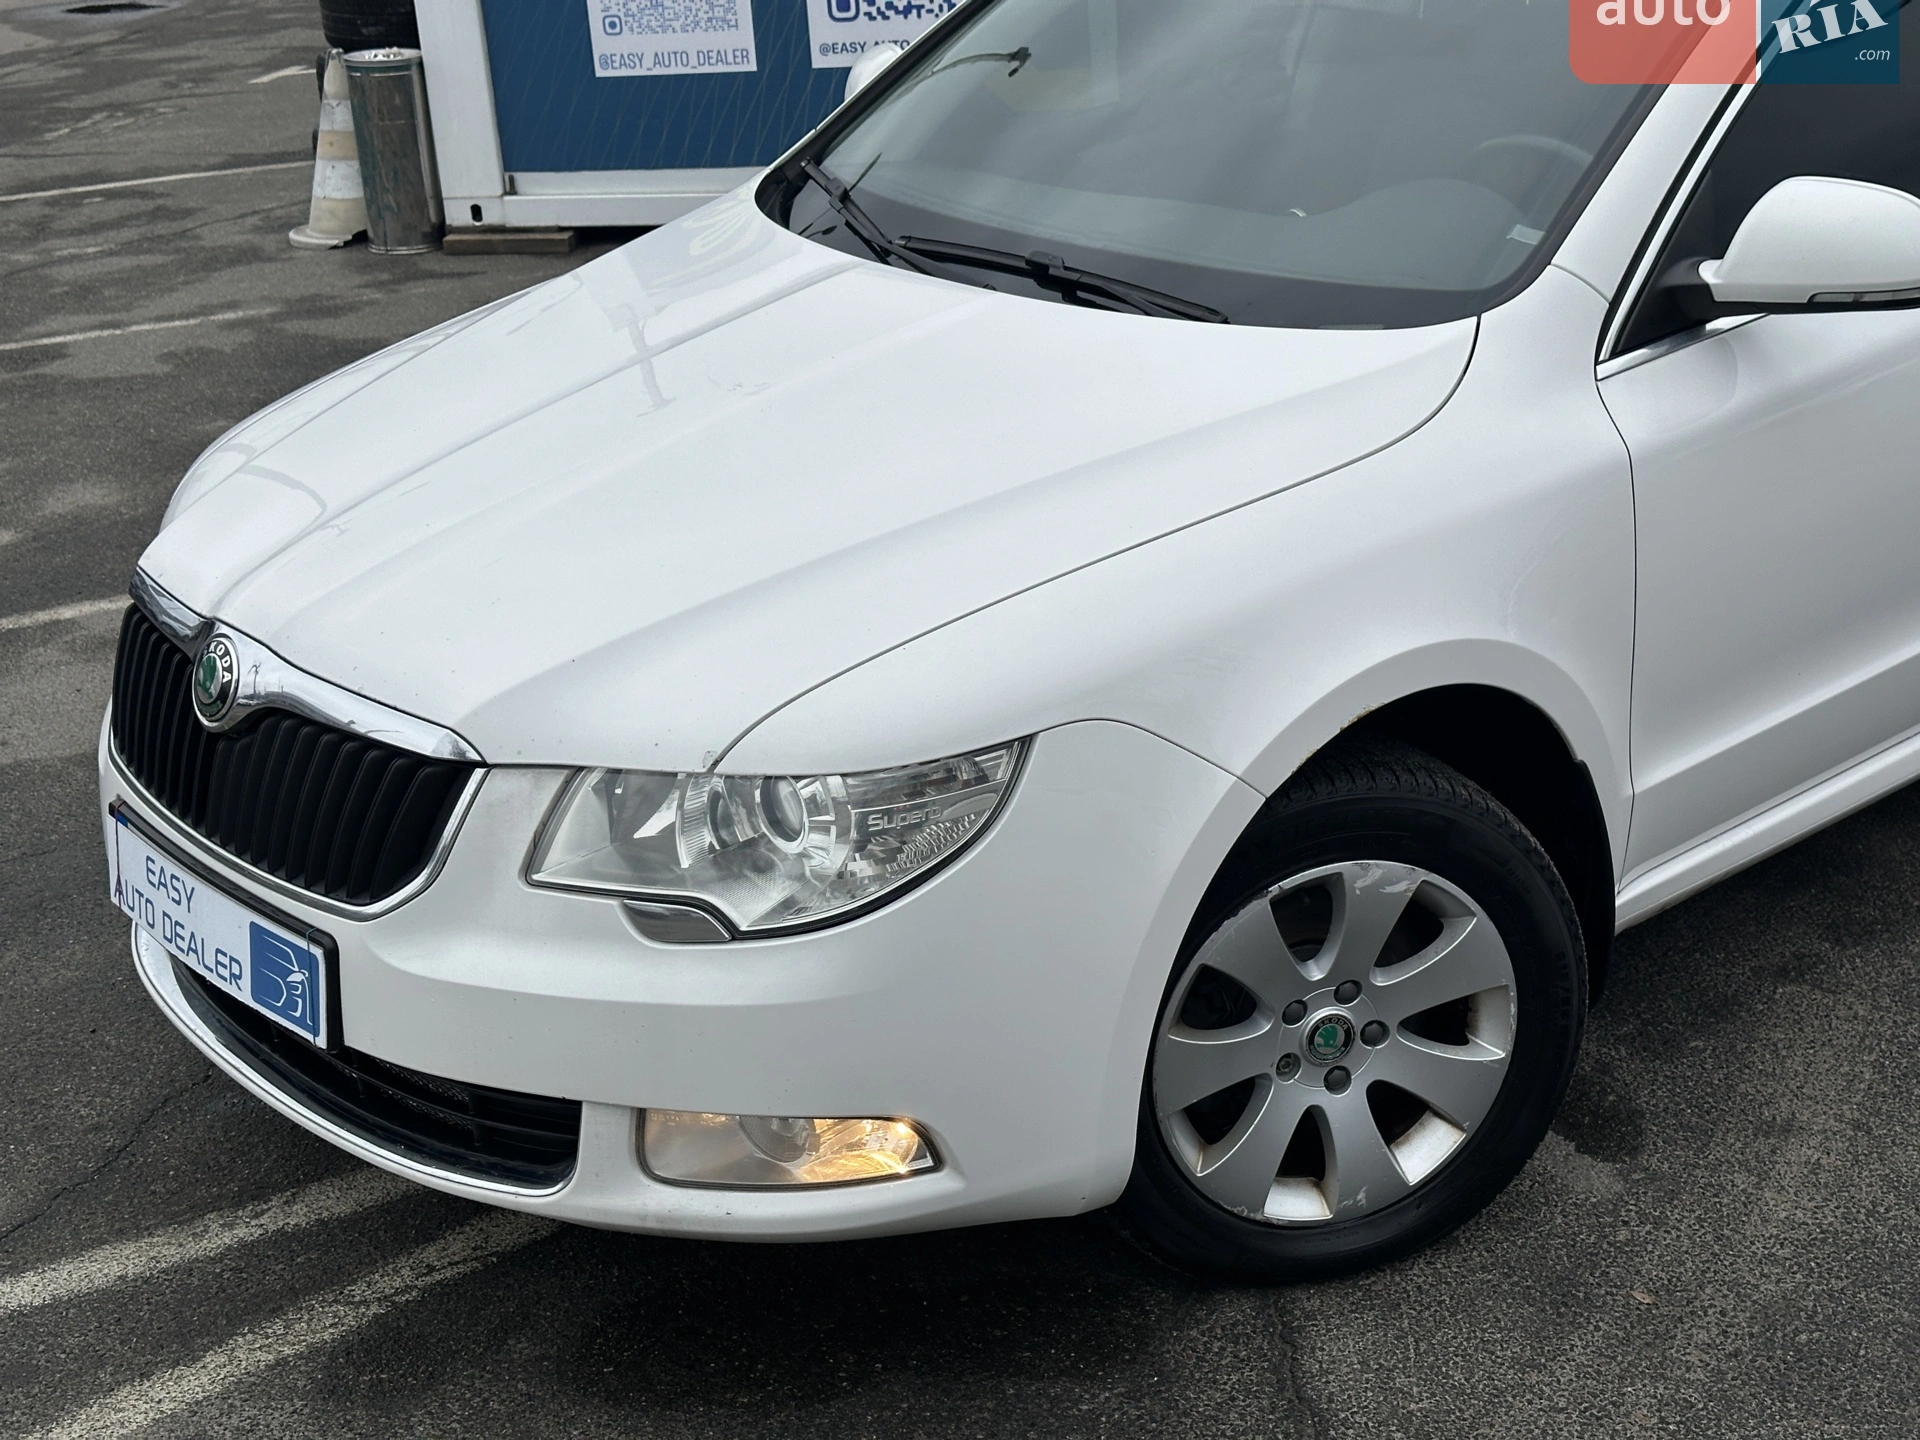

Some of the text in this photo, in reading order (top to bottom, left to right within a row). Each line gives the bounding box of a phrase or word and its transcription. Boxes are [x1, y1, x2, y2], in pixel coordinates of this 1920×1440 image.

[598, 48, 750, 71] @EASY_AUTO_DEALER
[145, 855, 195, 913] EASY
[114, 879, 243, 991] AUTO DEALER
